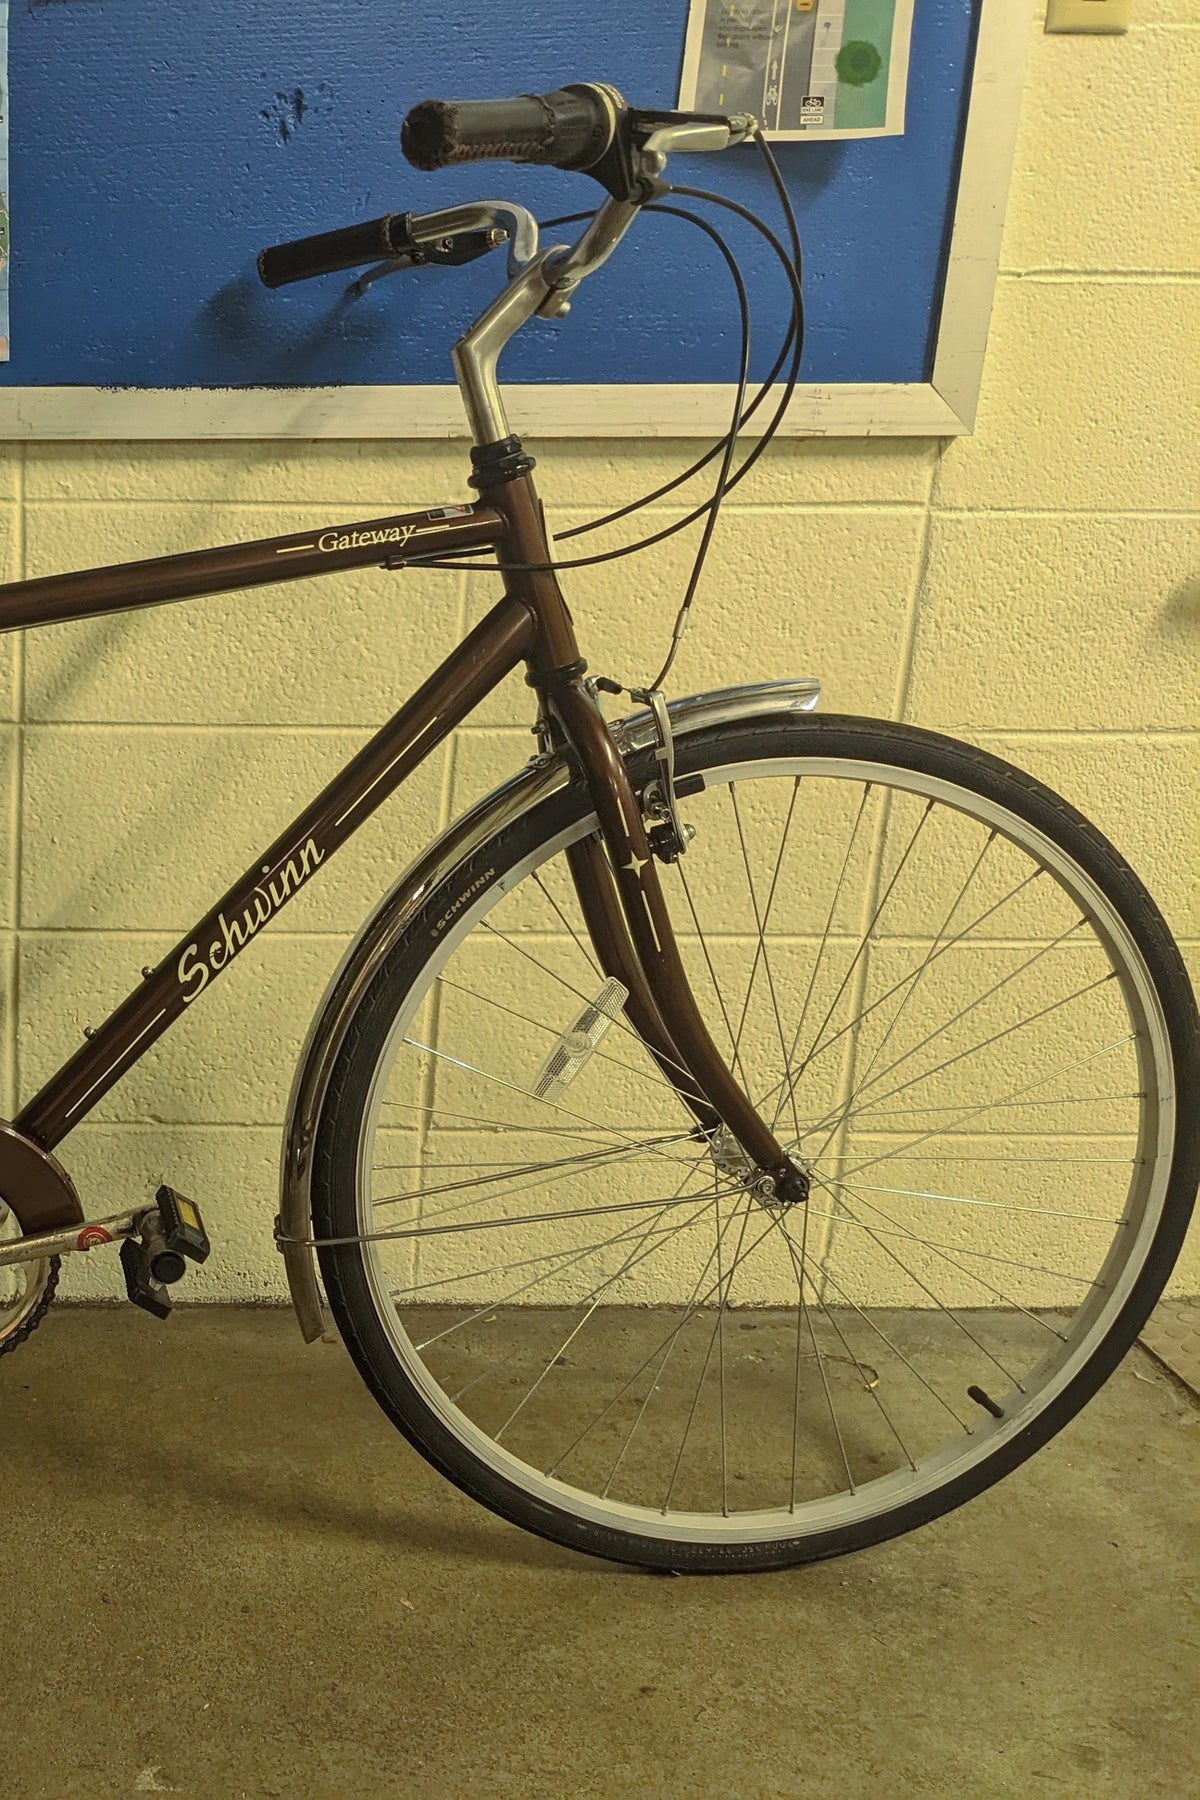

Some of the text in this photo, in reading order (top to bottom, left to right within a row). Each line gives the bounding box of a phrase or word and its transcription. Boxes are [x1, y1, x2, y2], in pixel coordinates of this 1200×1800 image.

[318, 524, 416, 552] Gateway
[177, 838, 325, 1003] Schwinn
[437, 868, 495, 930] SCHWINN
